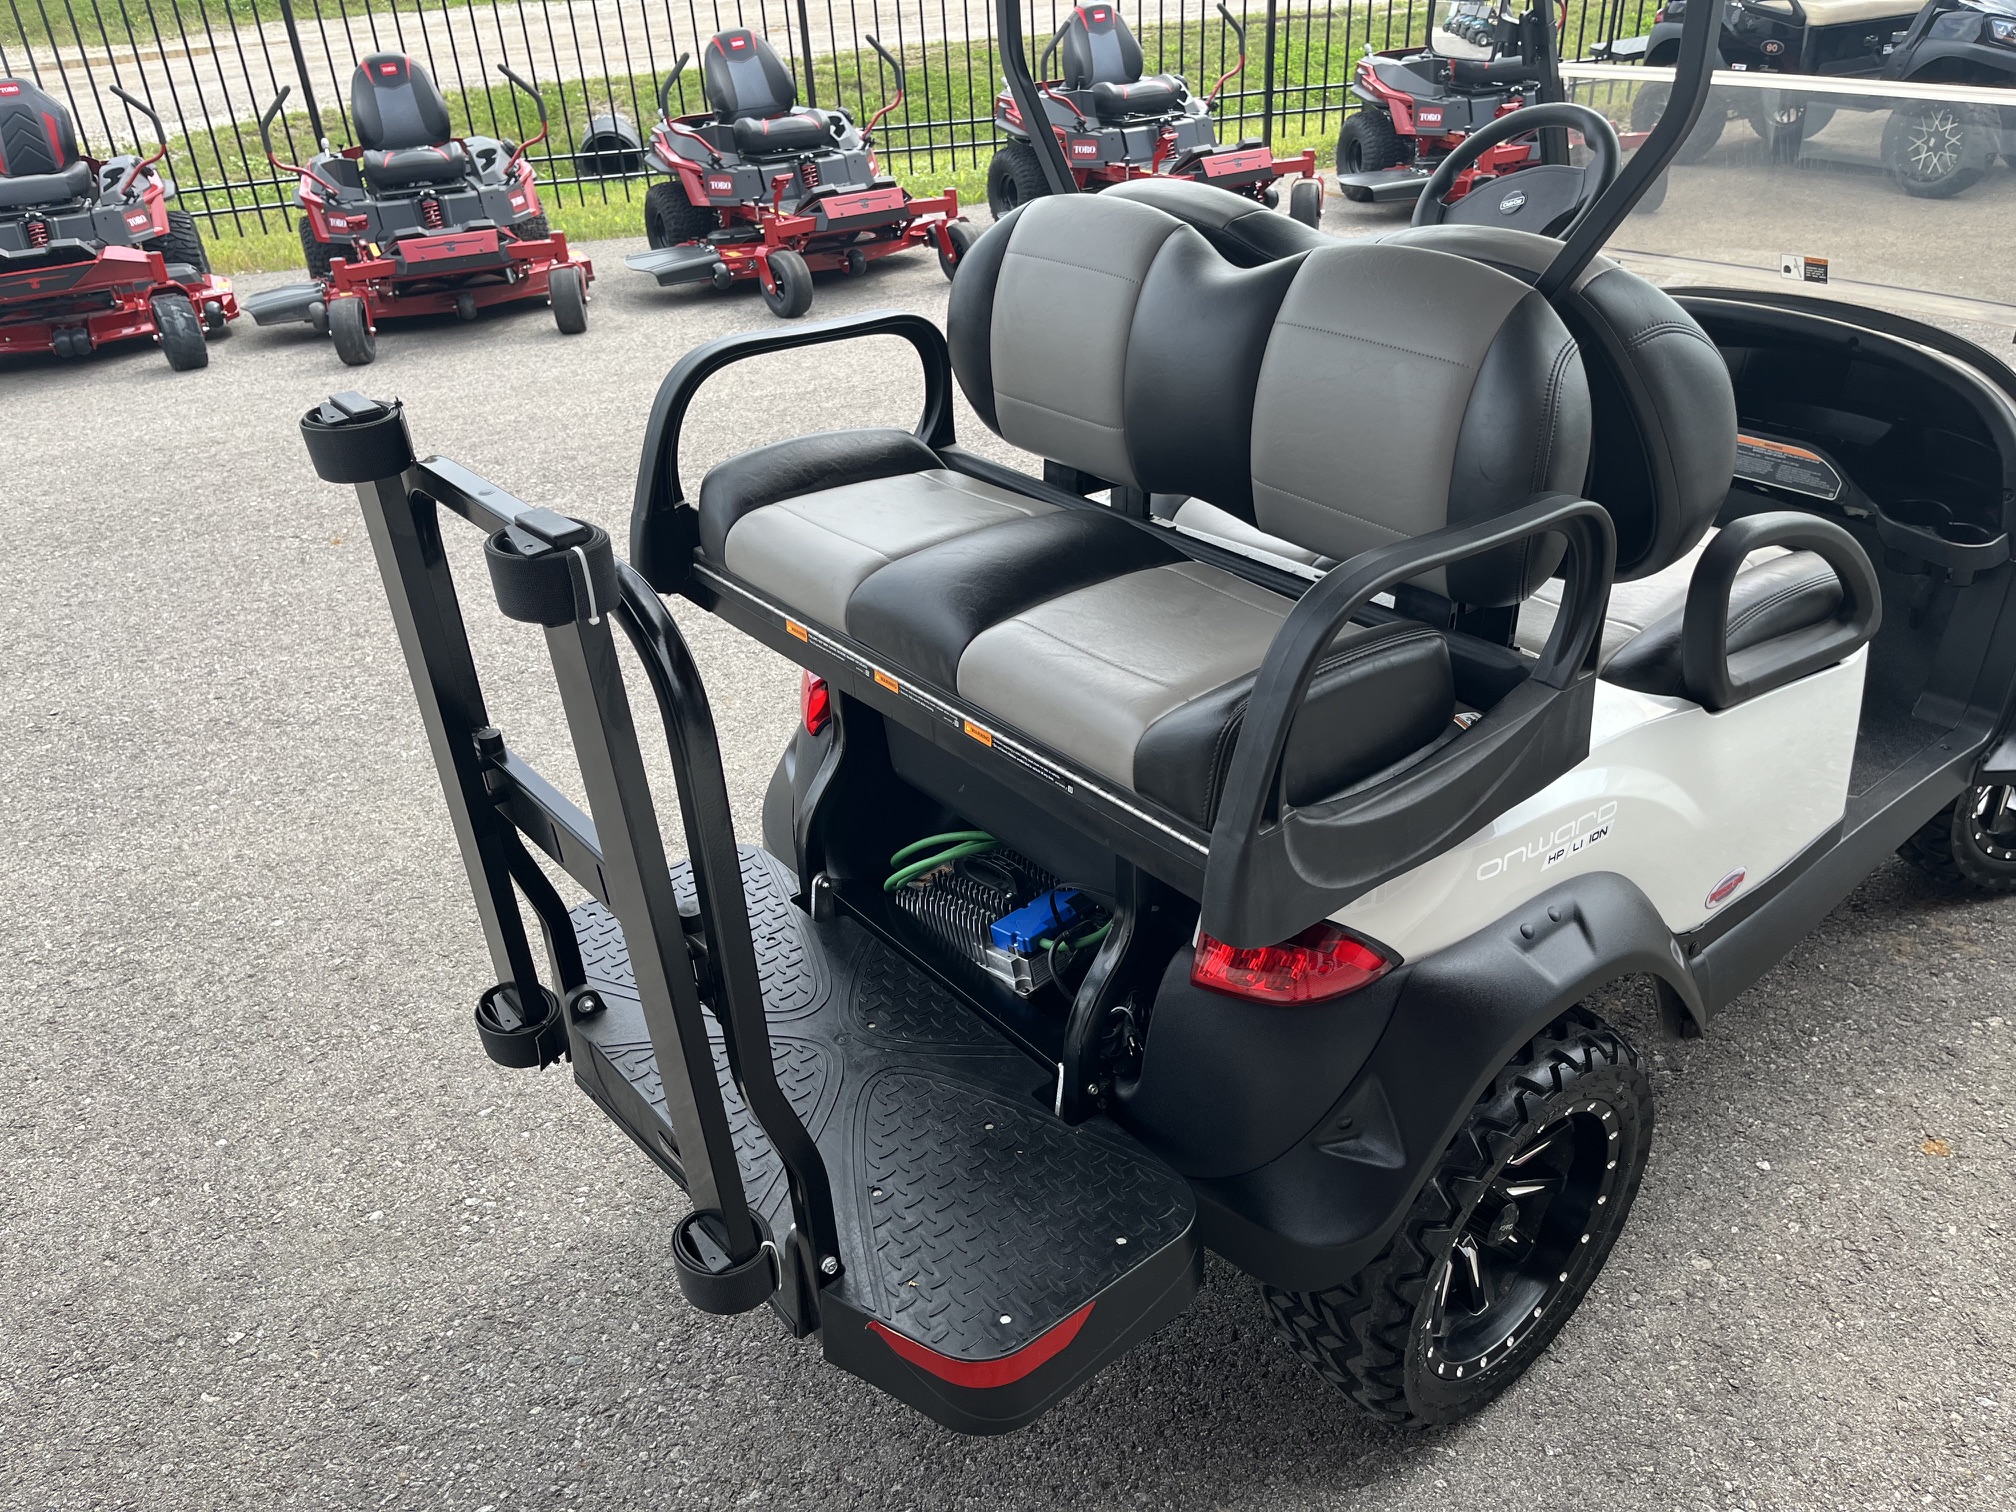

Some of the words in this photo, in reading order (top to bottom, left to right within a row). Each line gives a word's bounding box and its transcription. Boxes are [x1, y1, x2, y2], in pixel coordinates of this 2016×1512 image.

[1766, 43, 1778, 52] 90
[0, 86, 19, 94] TORO
[1420, 113, 1441, 122] TORO
[1073, 145, 1097, 154] TORO
[709, 181, 731, 190] TORO
[127, 214, 148, 227] TORO
[329, 217, 348, 228] TORO
[971, 728, 991, 743] WARNING
[1547, 848, 1565, 865] HP
[1588, 825, 1609, 844] ION
